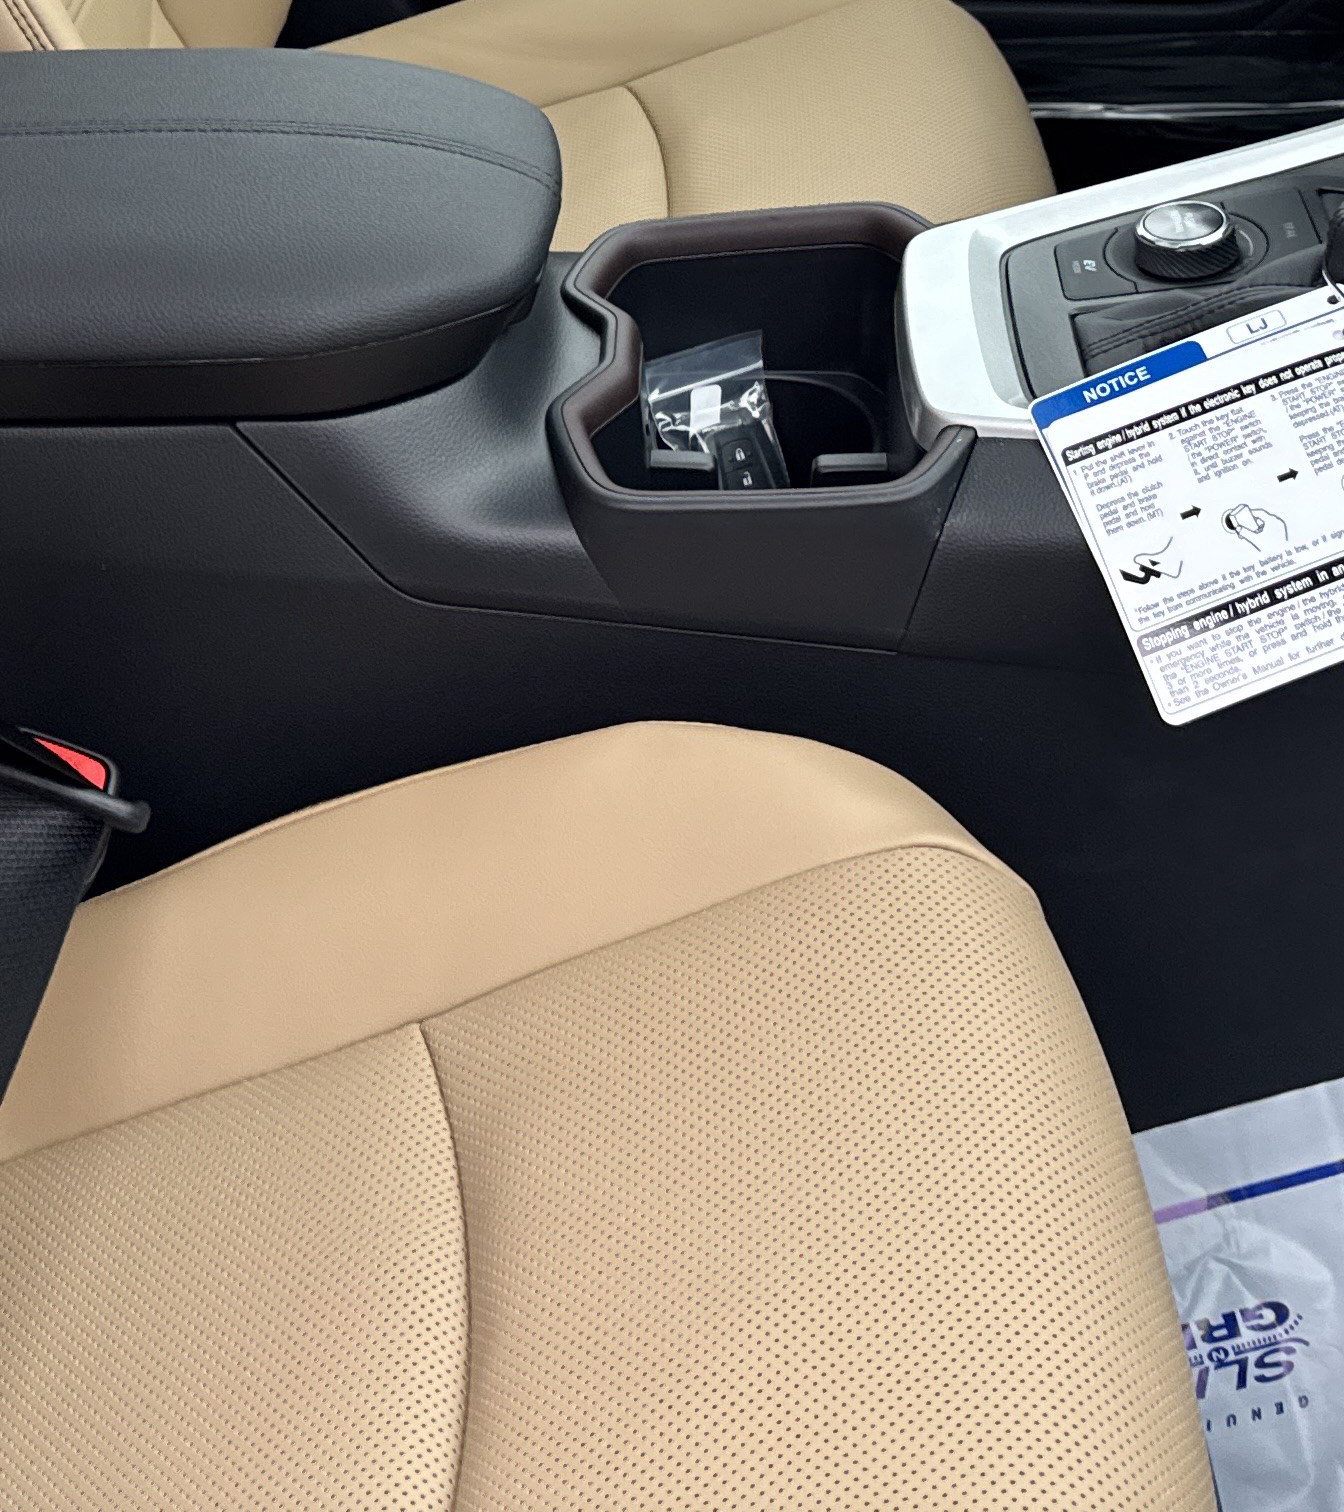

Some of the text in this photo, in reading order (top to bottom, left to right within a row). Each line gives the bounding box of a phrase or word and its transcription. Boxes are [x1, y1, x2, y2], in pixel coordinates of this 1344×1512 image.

[1246, 318, 1268, 334] LJ
[1065, 444, 1096, 461] Starting
[1152, 412, 1182, 434] system
[1179, 407, 1190, 423] if
[1188, 404, 1205, 420] the
[1203, 389, 1243, 414] electronic
[1240, 384, 1259, 401] key
[1258, 375, 1281, 394] does
[1279, 369, 1296, 387] not
[1294, 359, 1326, 381] operate
[1083, 366, 1151, 403] NOTICE
[1141, 625, 1191, 651] Stopping
[1235, 591, 1270, 614] hybrid
[1274, 577, 1313, 599] system
